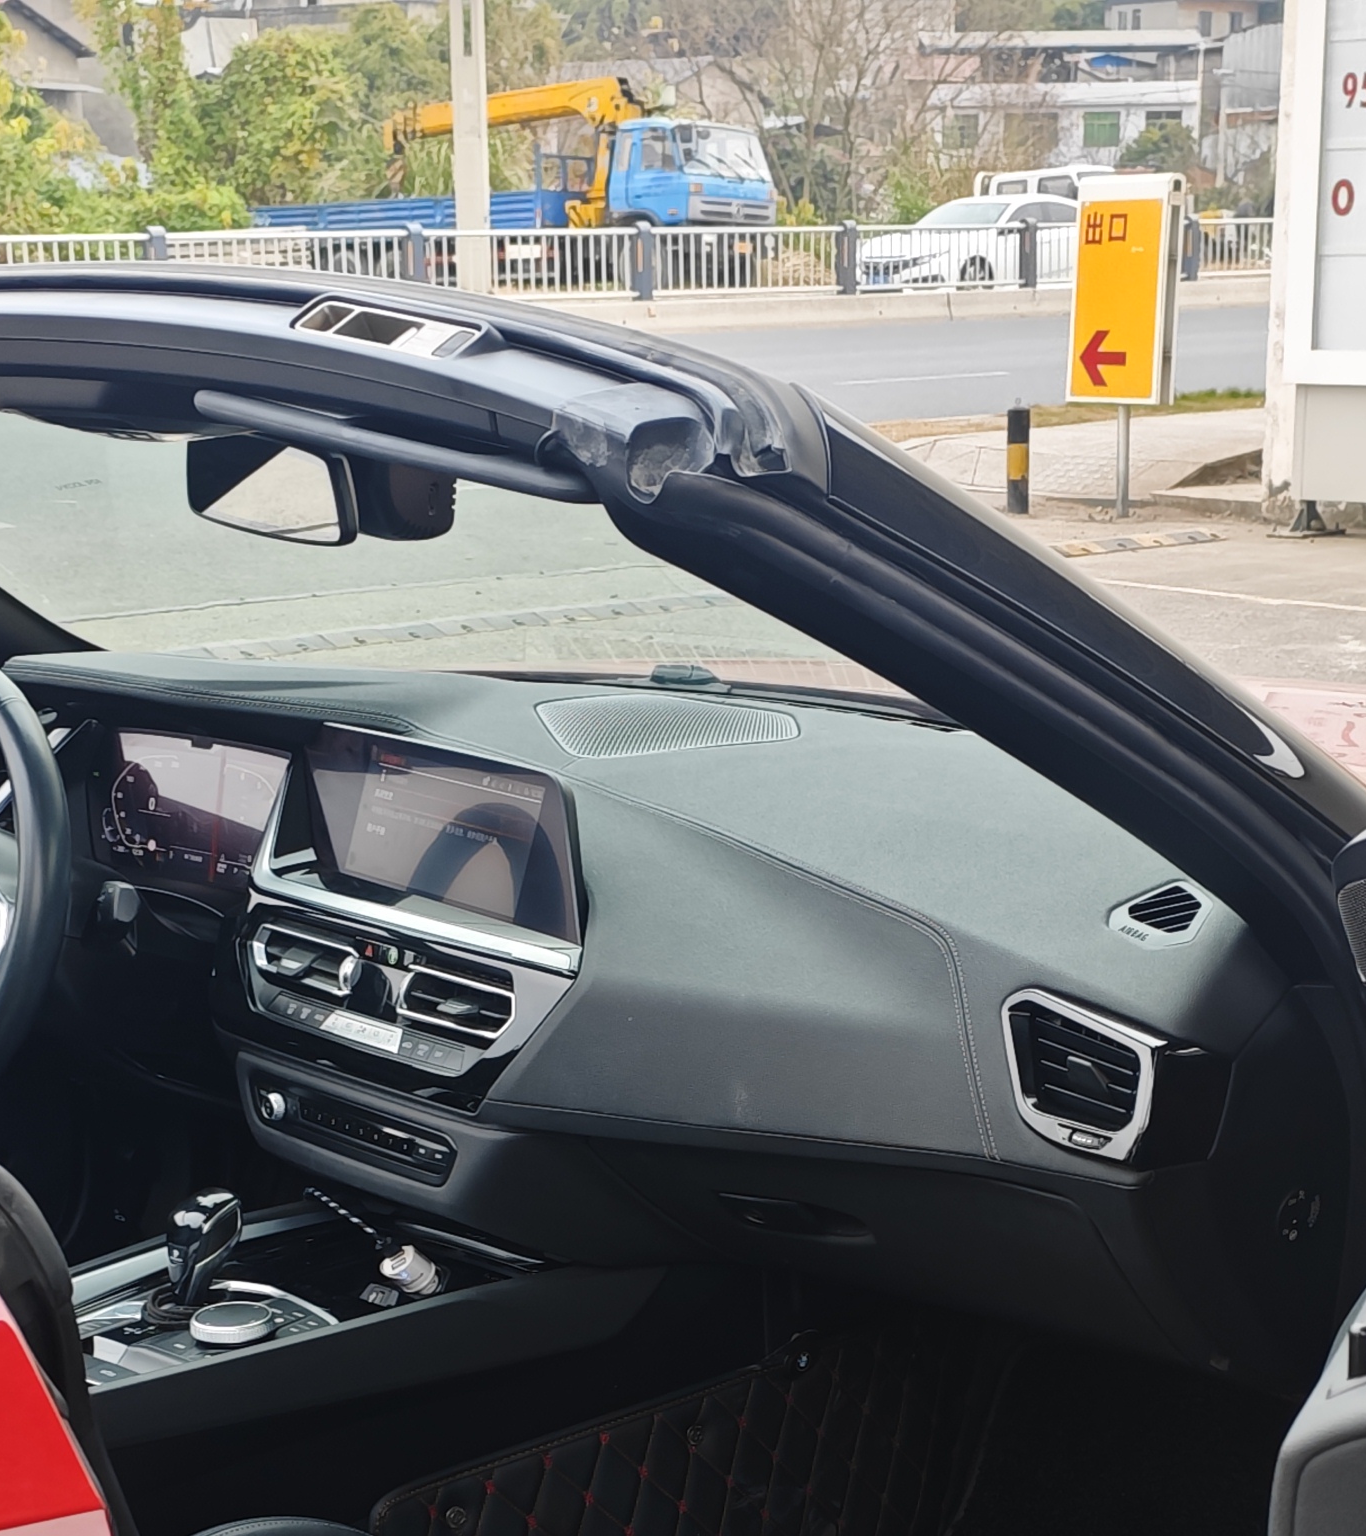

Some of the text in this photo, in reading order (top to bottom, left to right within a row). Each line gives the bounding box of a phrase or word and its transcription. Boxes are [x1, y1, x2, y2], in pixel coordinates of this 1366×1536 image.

[1331, 178, 1355, 216] 0
[1085, 212, 1128, 245] 出口
[1117, 924, 1150, 942] AIRBAG
